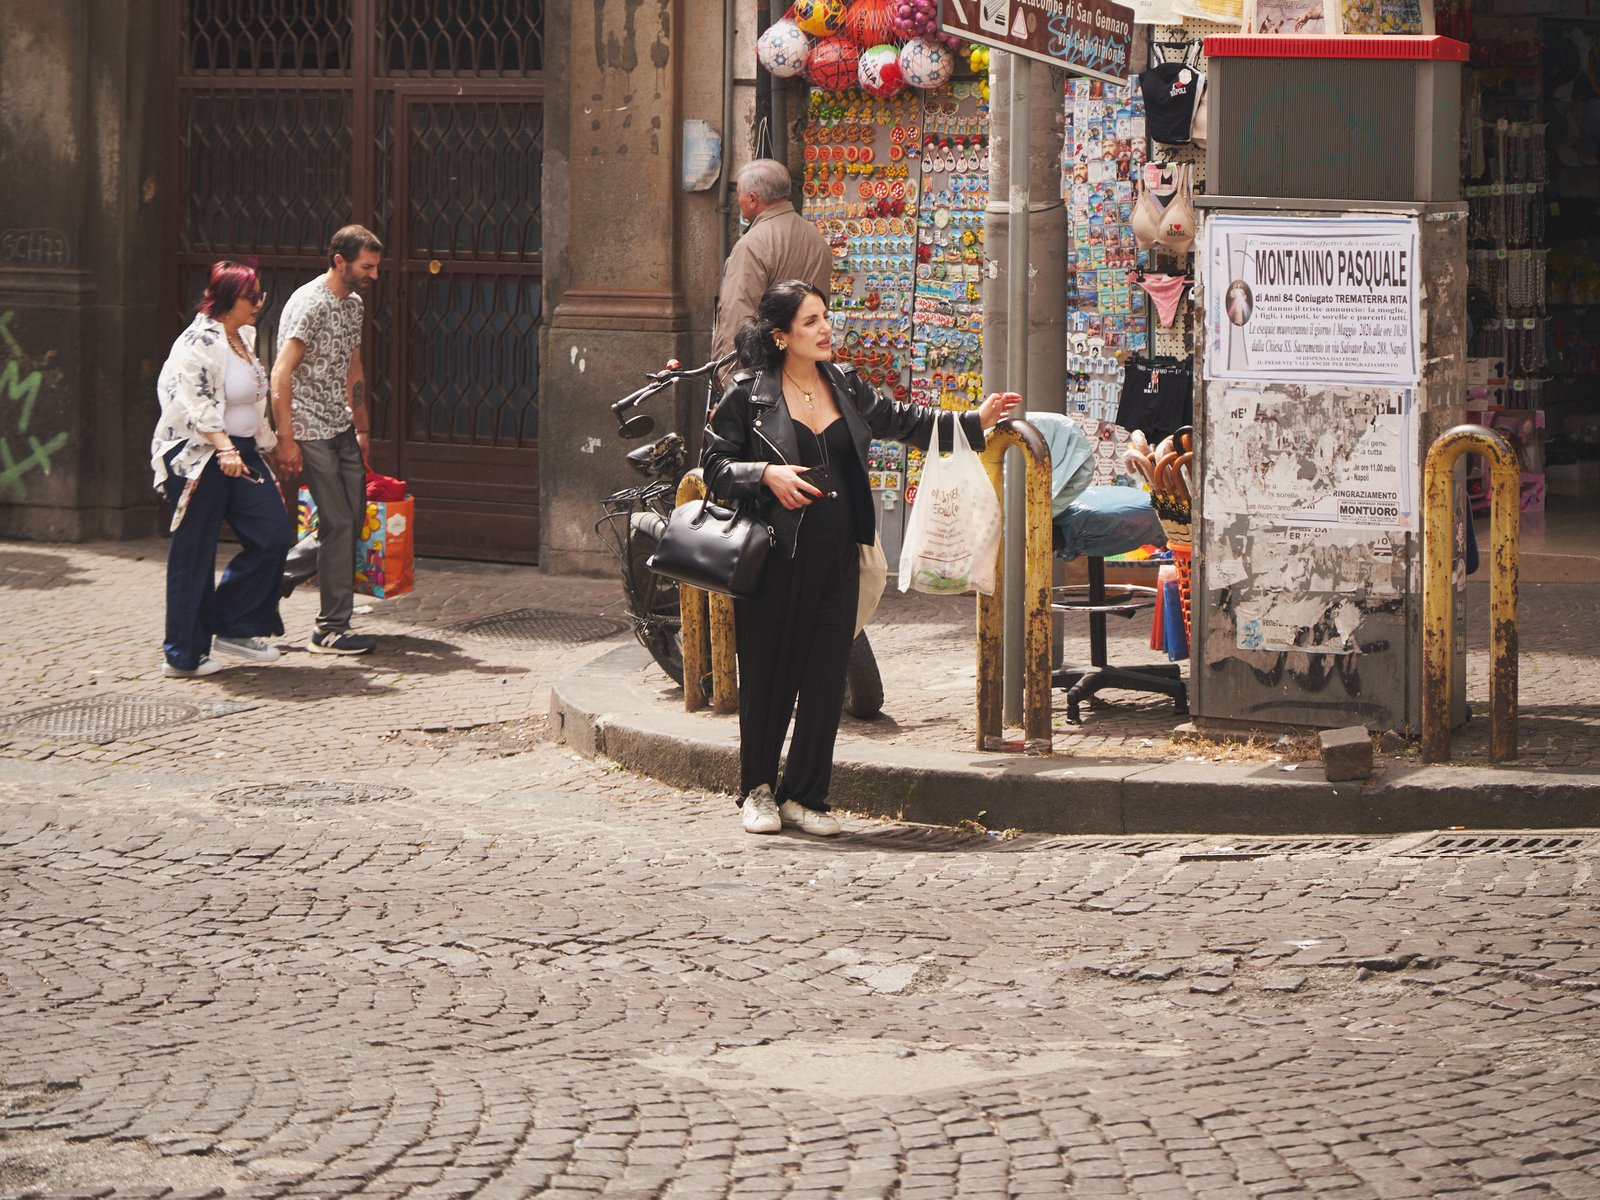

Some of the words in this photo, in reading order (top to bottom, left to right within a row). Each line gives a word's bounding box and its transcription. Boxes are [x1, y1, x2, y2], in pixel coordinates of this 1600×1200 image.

[1065, 0, 1075, 19] di
[1076, 2, 1092, 25] San
[1095, 9, 1129, 36] Gennaro
[1255, 250, 1334, 286] MONTANINO
[1338, 250, 1407, 293] PASQUALE
[1255, 294, 1262, 302] di
[1264, 294, 1281, 302] Anni
[1283, 294, 1293, 303] 84
[1295, 294, 1334, 305] Coniugato
[1335, 294, 1388, 304] TREMATERRA
[1390, 295, 1408, 304] RITA
[1314, 323, 1332, 338] giorno
[1338, 323, 1357, 339] Maggio
[1373, 323, 1382, 336] alle
[1383, 326, 1392, 336] ore
[1266, 339, 1283, 352] Chiesa
[1294, 340, 1324, 353] Sacramento
[1390, 342, 1407, 358] Napoli
[1078, 403, 1085, 411] 10
[1384, 464, 1396, 473] nella
[1354, 473, 1370, 483] Napoli
[1332, 490, 1397, 500] RINGRAZIAMENTO
[1340, 505, 1398, 517] MONTUORO
